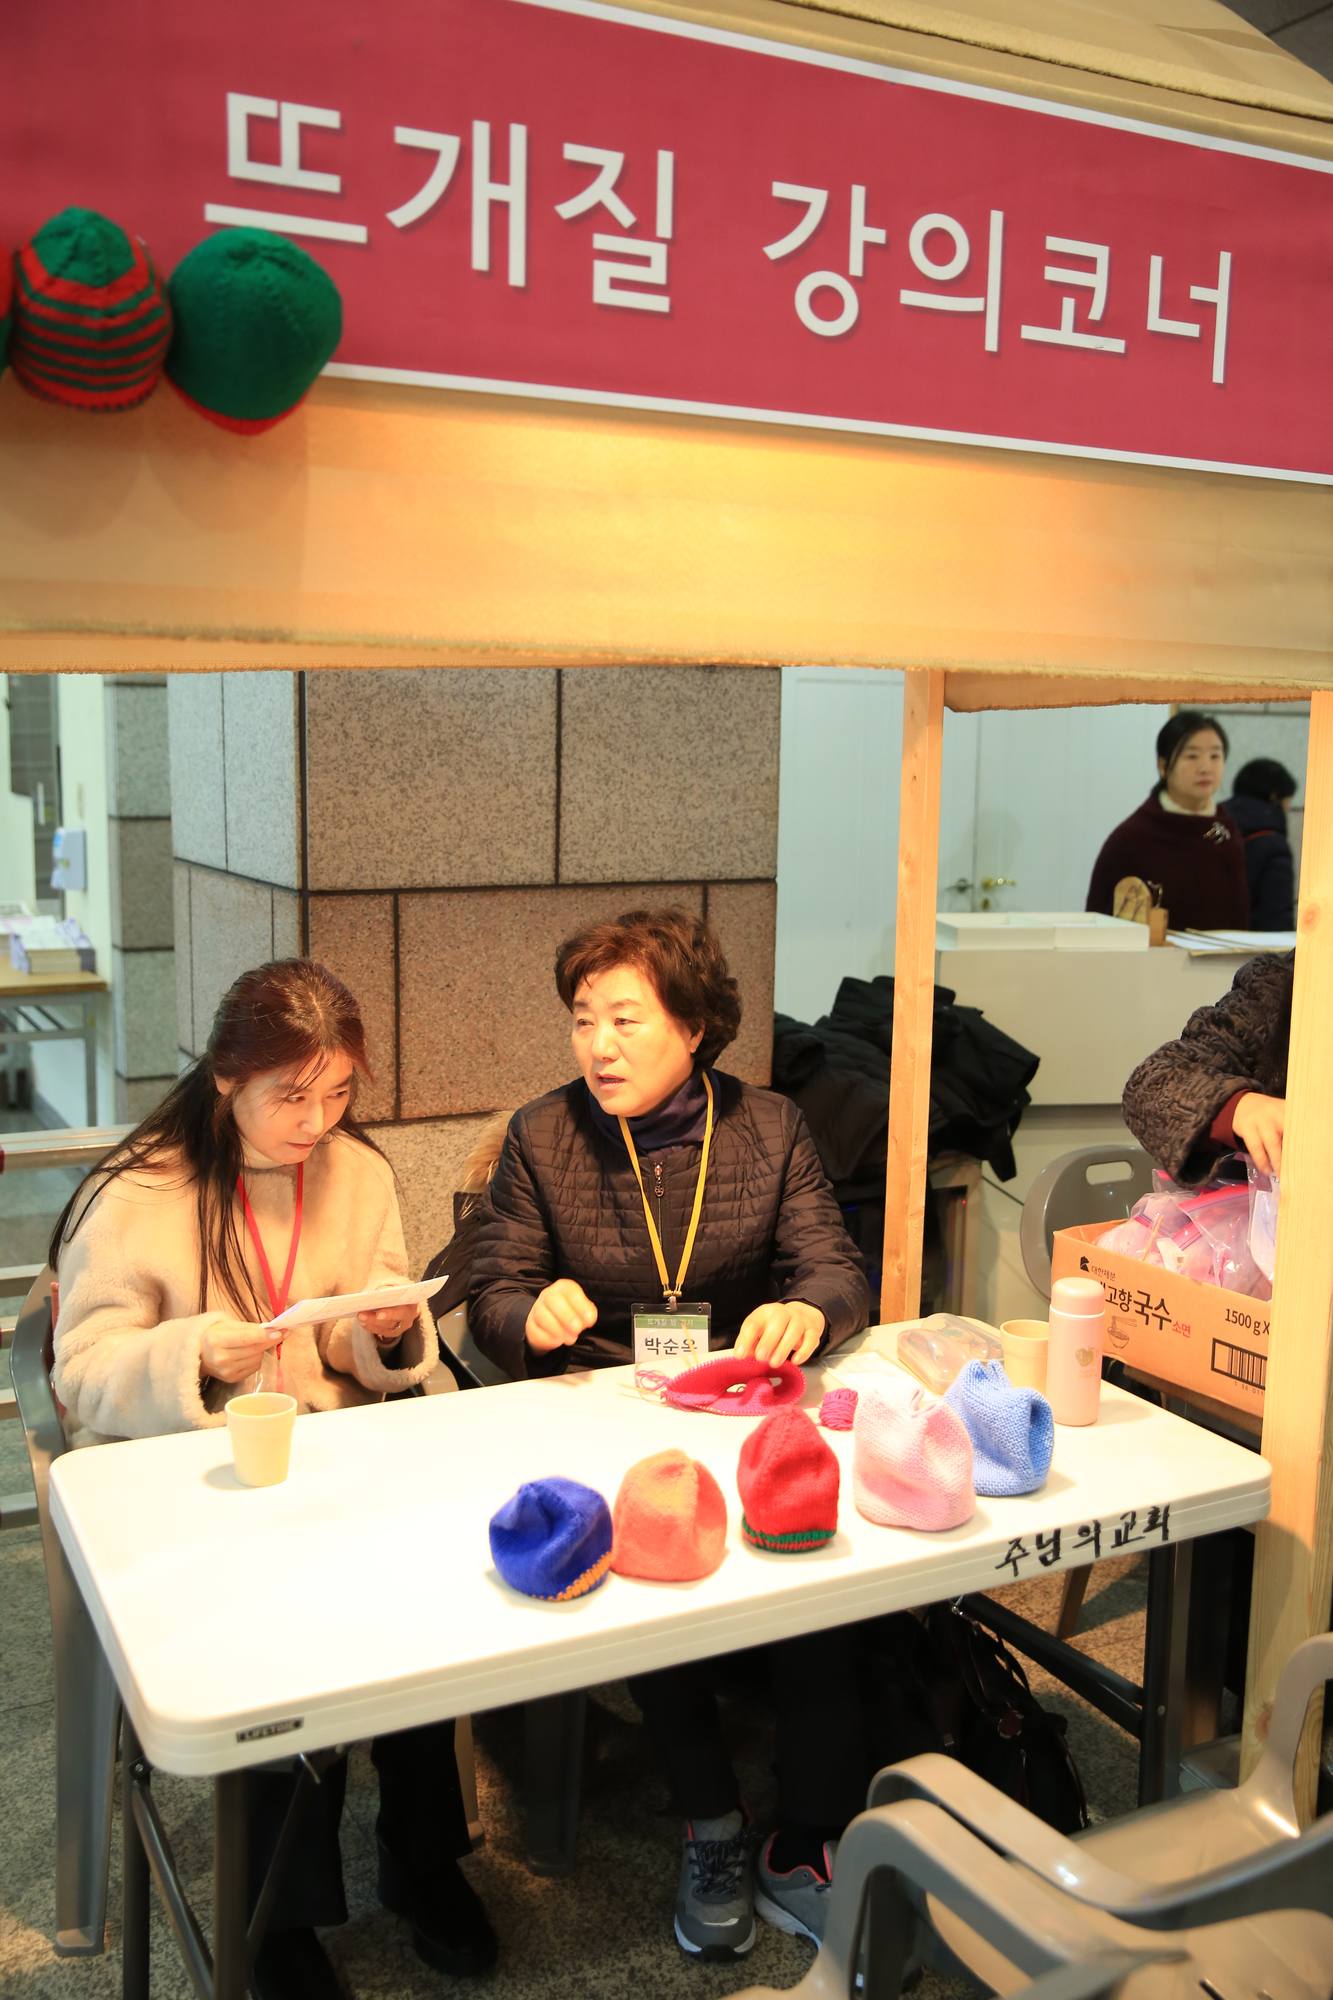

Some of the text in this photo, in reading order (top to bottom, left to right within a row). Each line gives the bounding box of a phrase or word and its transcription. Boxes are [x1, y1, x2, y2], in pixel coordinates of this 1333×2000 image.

[204, 92, 1233, 385] 뜨개질 강의코너
[1100, 1282, 1191, 1338] 고향국수 소면
